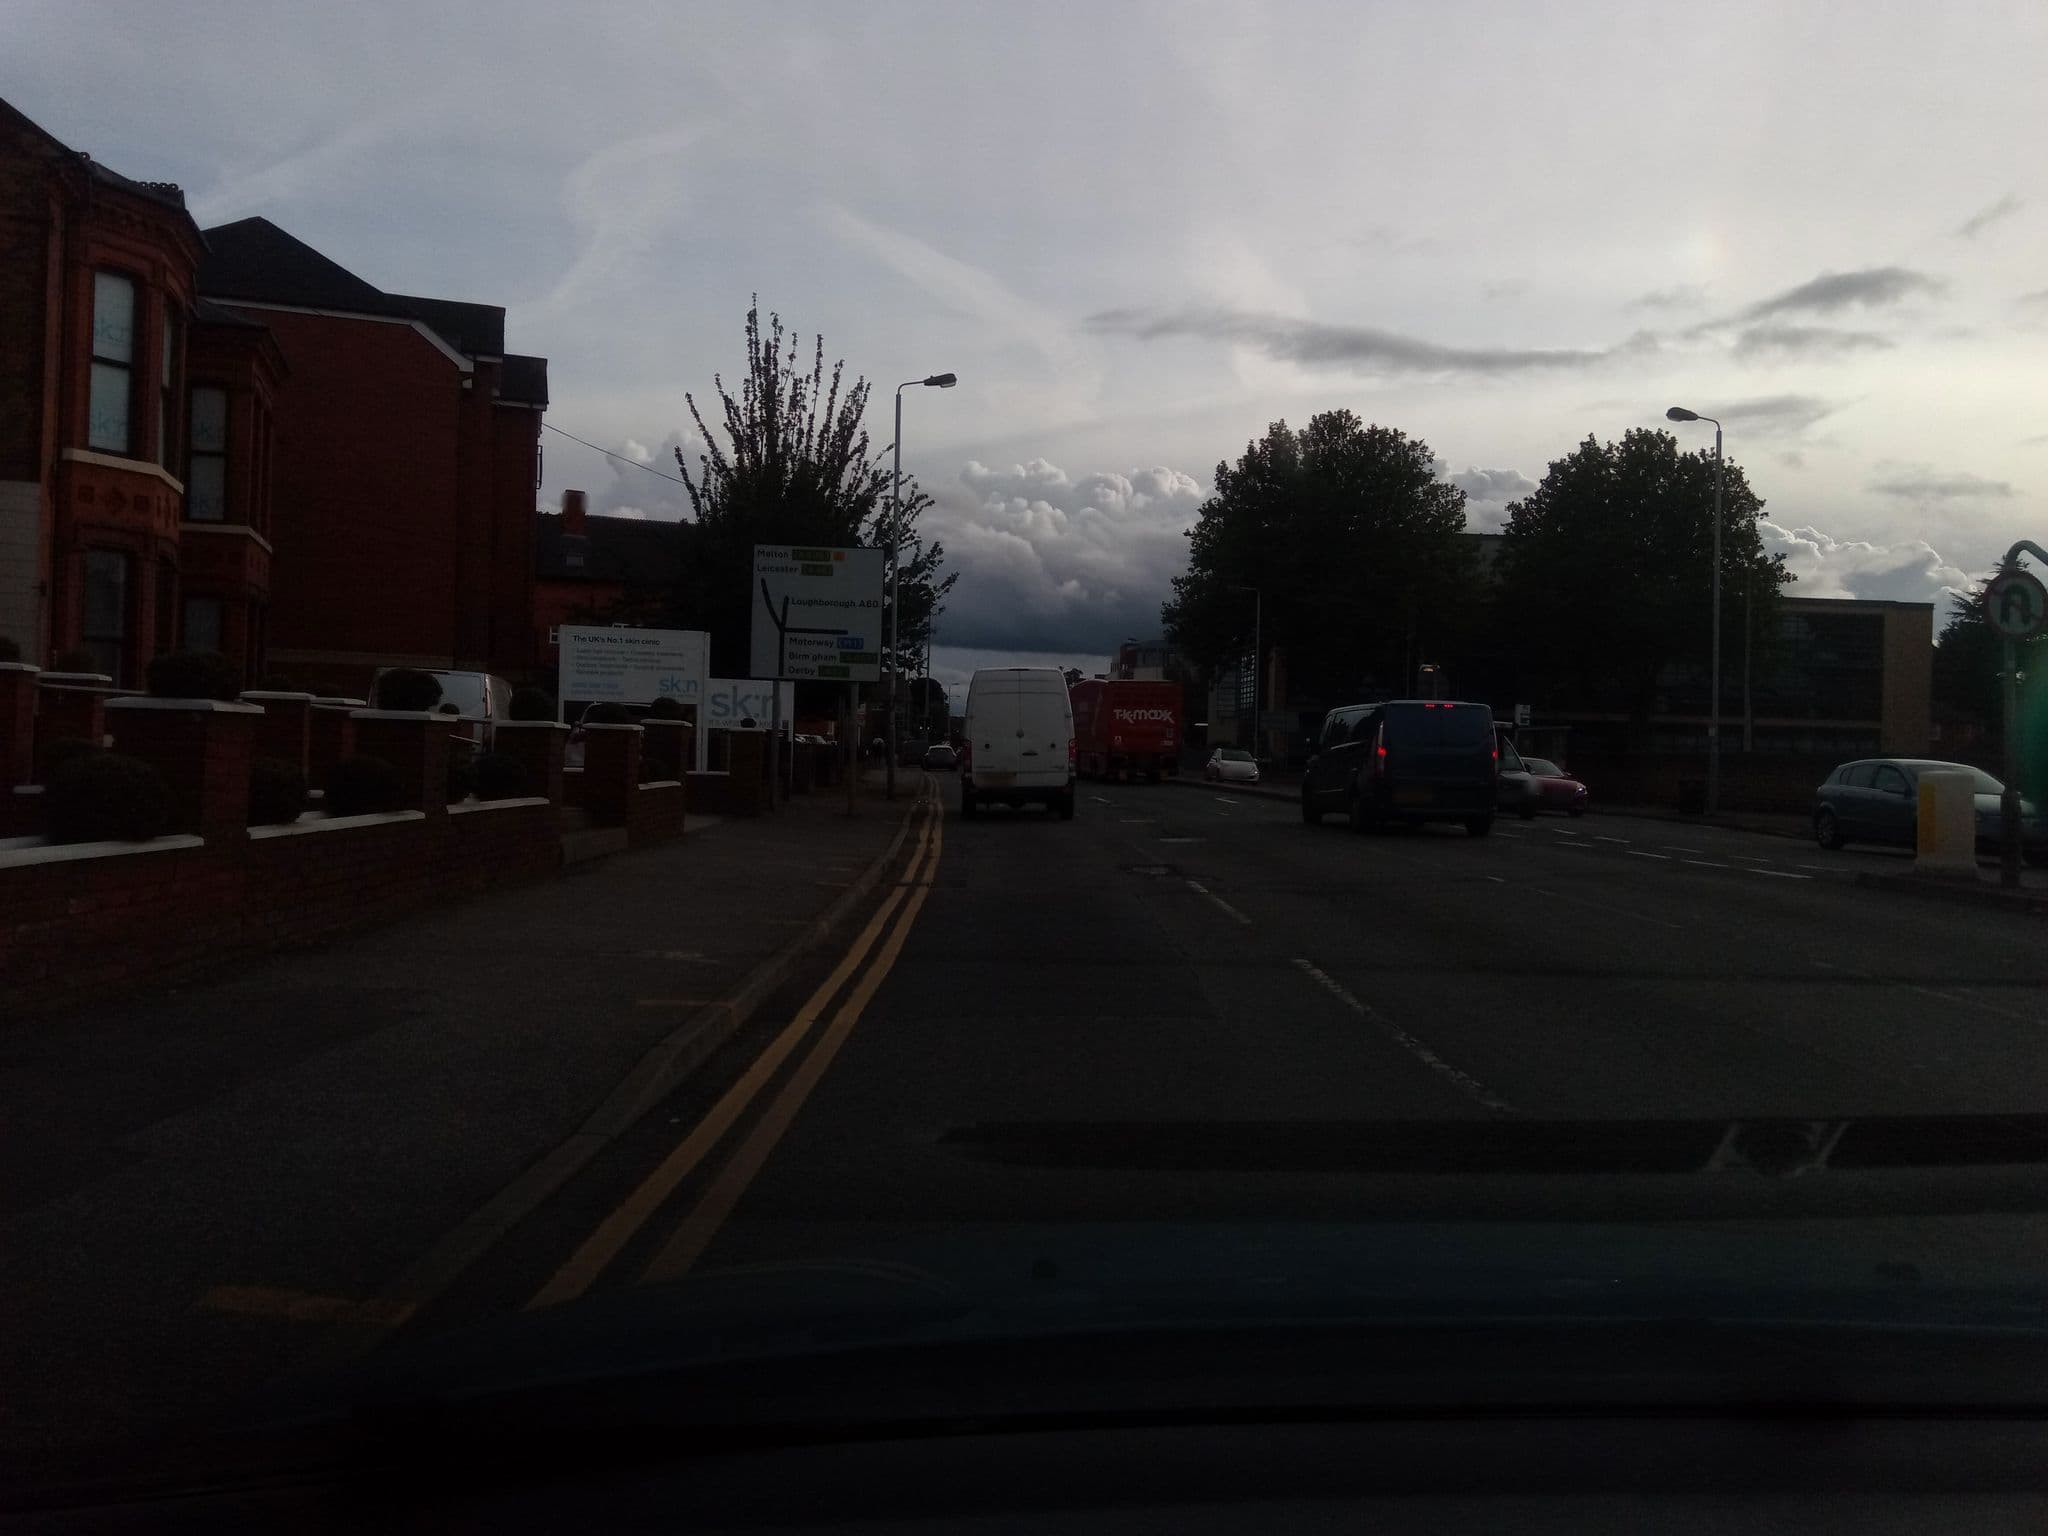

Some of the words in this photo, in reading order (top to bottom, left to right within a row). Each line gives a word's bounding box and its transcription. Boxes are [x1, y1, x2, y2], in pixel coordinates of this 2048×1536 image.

[791, 598, 856, 609] Loughborough
[789, 638, 834, 649] Motorway
[788, 652, 836, 662] Birmgham
[788, 666, 815, 676] Derby
